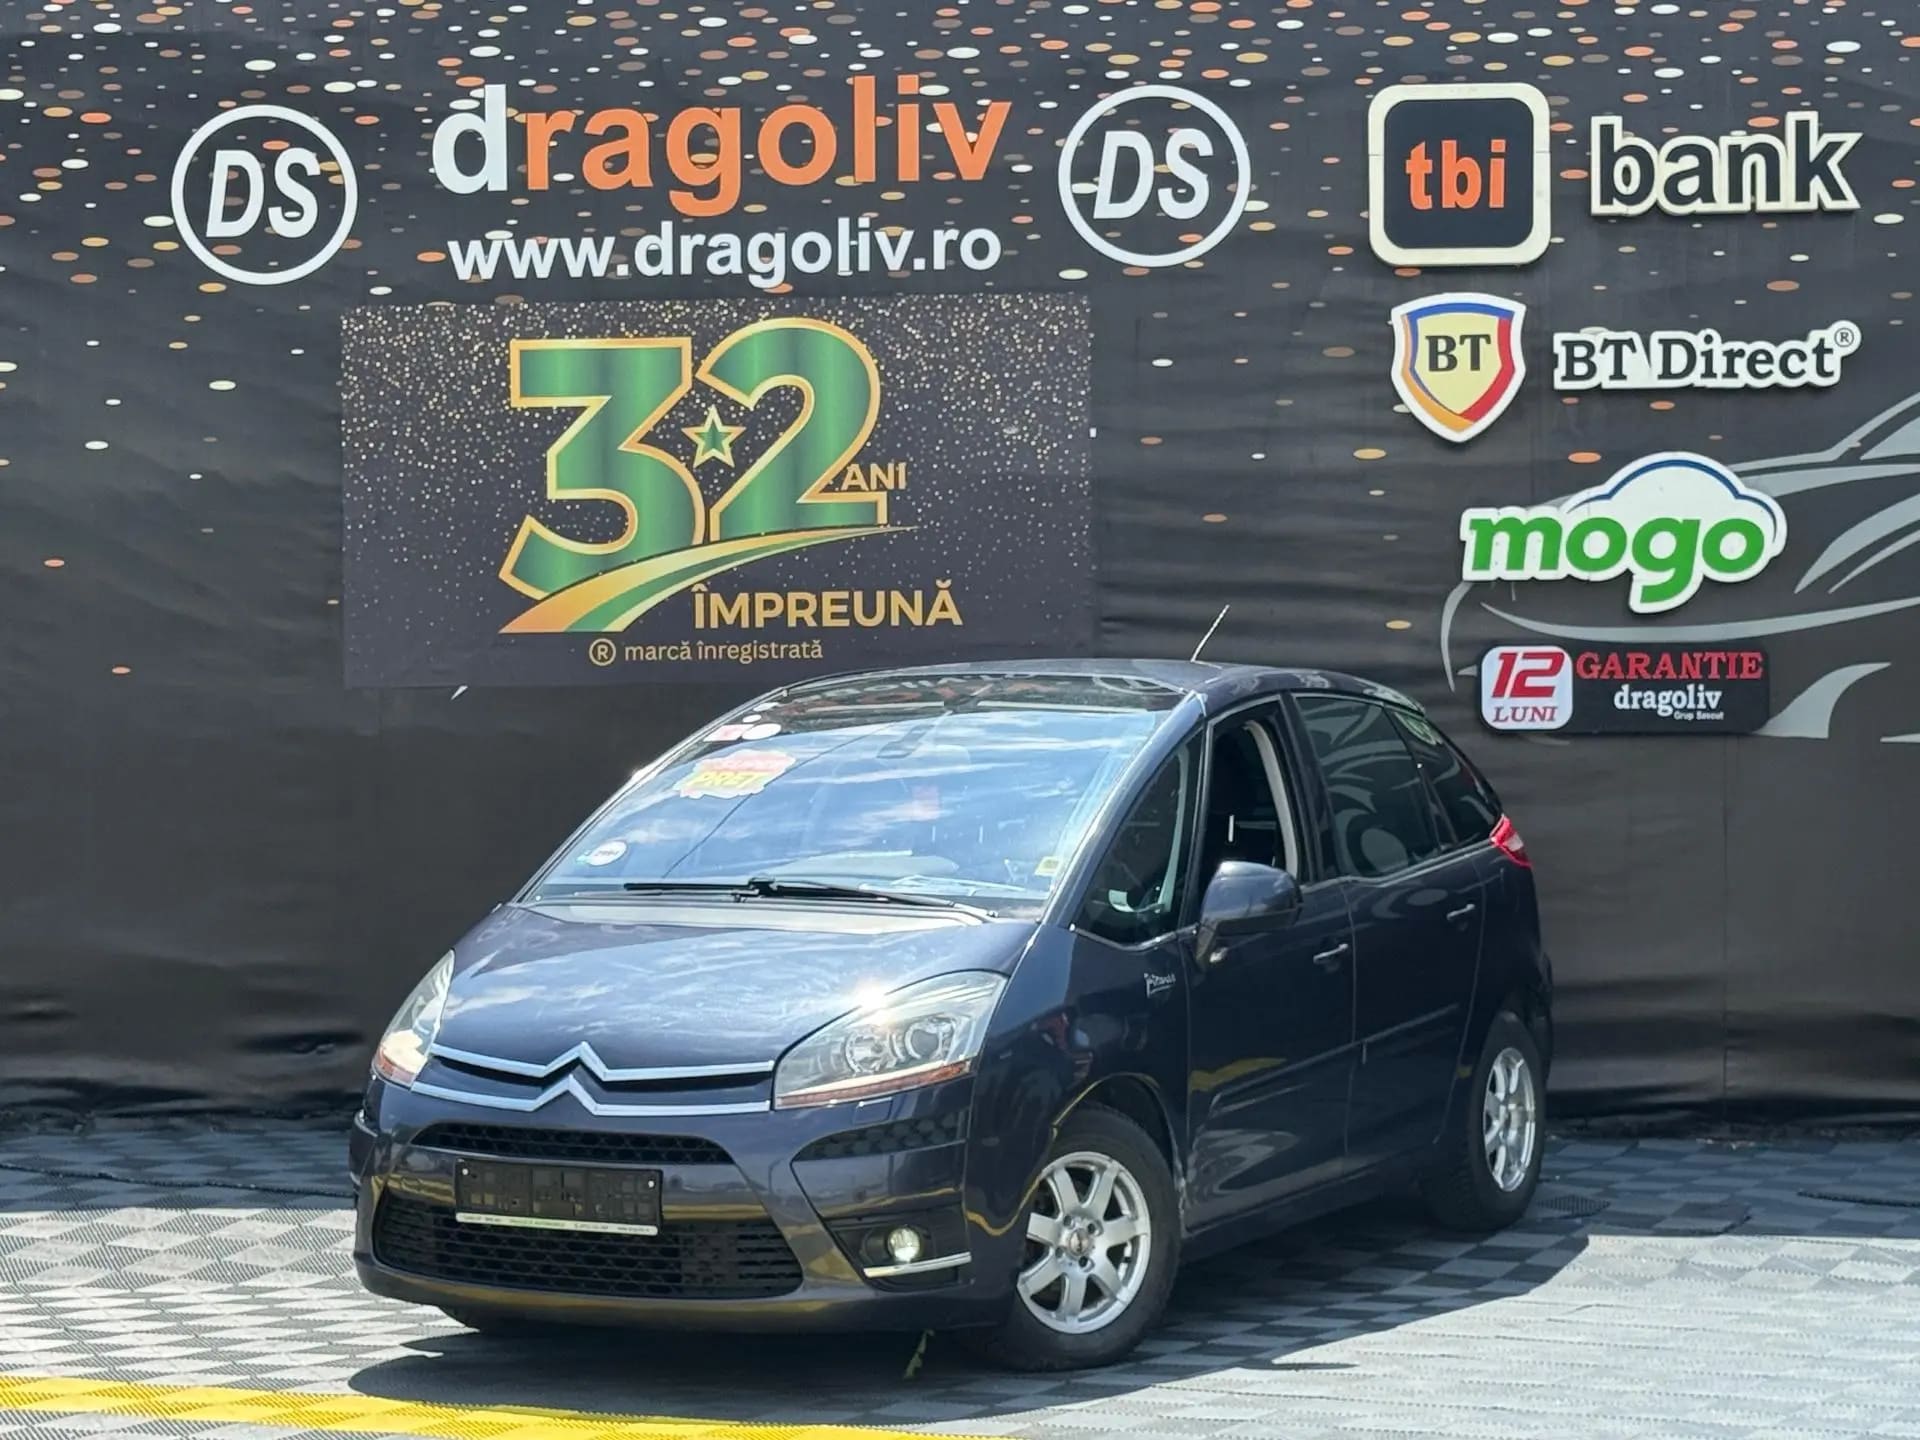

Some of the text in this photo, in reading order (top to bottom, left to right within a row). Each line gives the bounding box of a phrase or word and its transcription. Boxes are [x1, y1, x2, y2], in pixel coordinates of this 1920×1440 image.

[432, 74, 1013, 217] dragoliv
[1405, 115, 1857, 210] tbi bank
[206, 147, 321, 239] DS
[1093, 127, 1214, 220] DS
[447, 217, 1002, 289] www.dragoliv.ro
[1425, 333, 1491, 372] BT
[1561, 337, 1637, 382] BT
[499, 317, 888, 601] 32
[840, 462, 907, 492] ANI
[1469, 516, 1765, 603] mogo
[691, 579, 963, 629] ÎMPREUNĂ
[625, 640, 692, 662] marcă
[697, 638, 823, 665] înregistrată
[1491, 651, 1564, 698] 12
[1576, 651, 1764, 681] GARANTIE
[1492, 705, 1558, 723] LUNI
[1614, 683, 1722, 717] dragoliv
